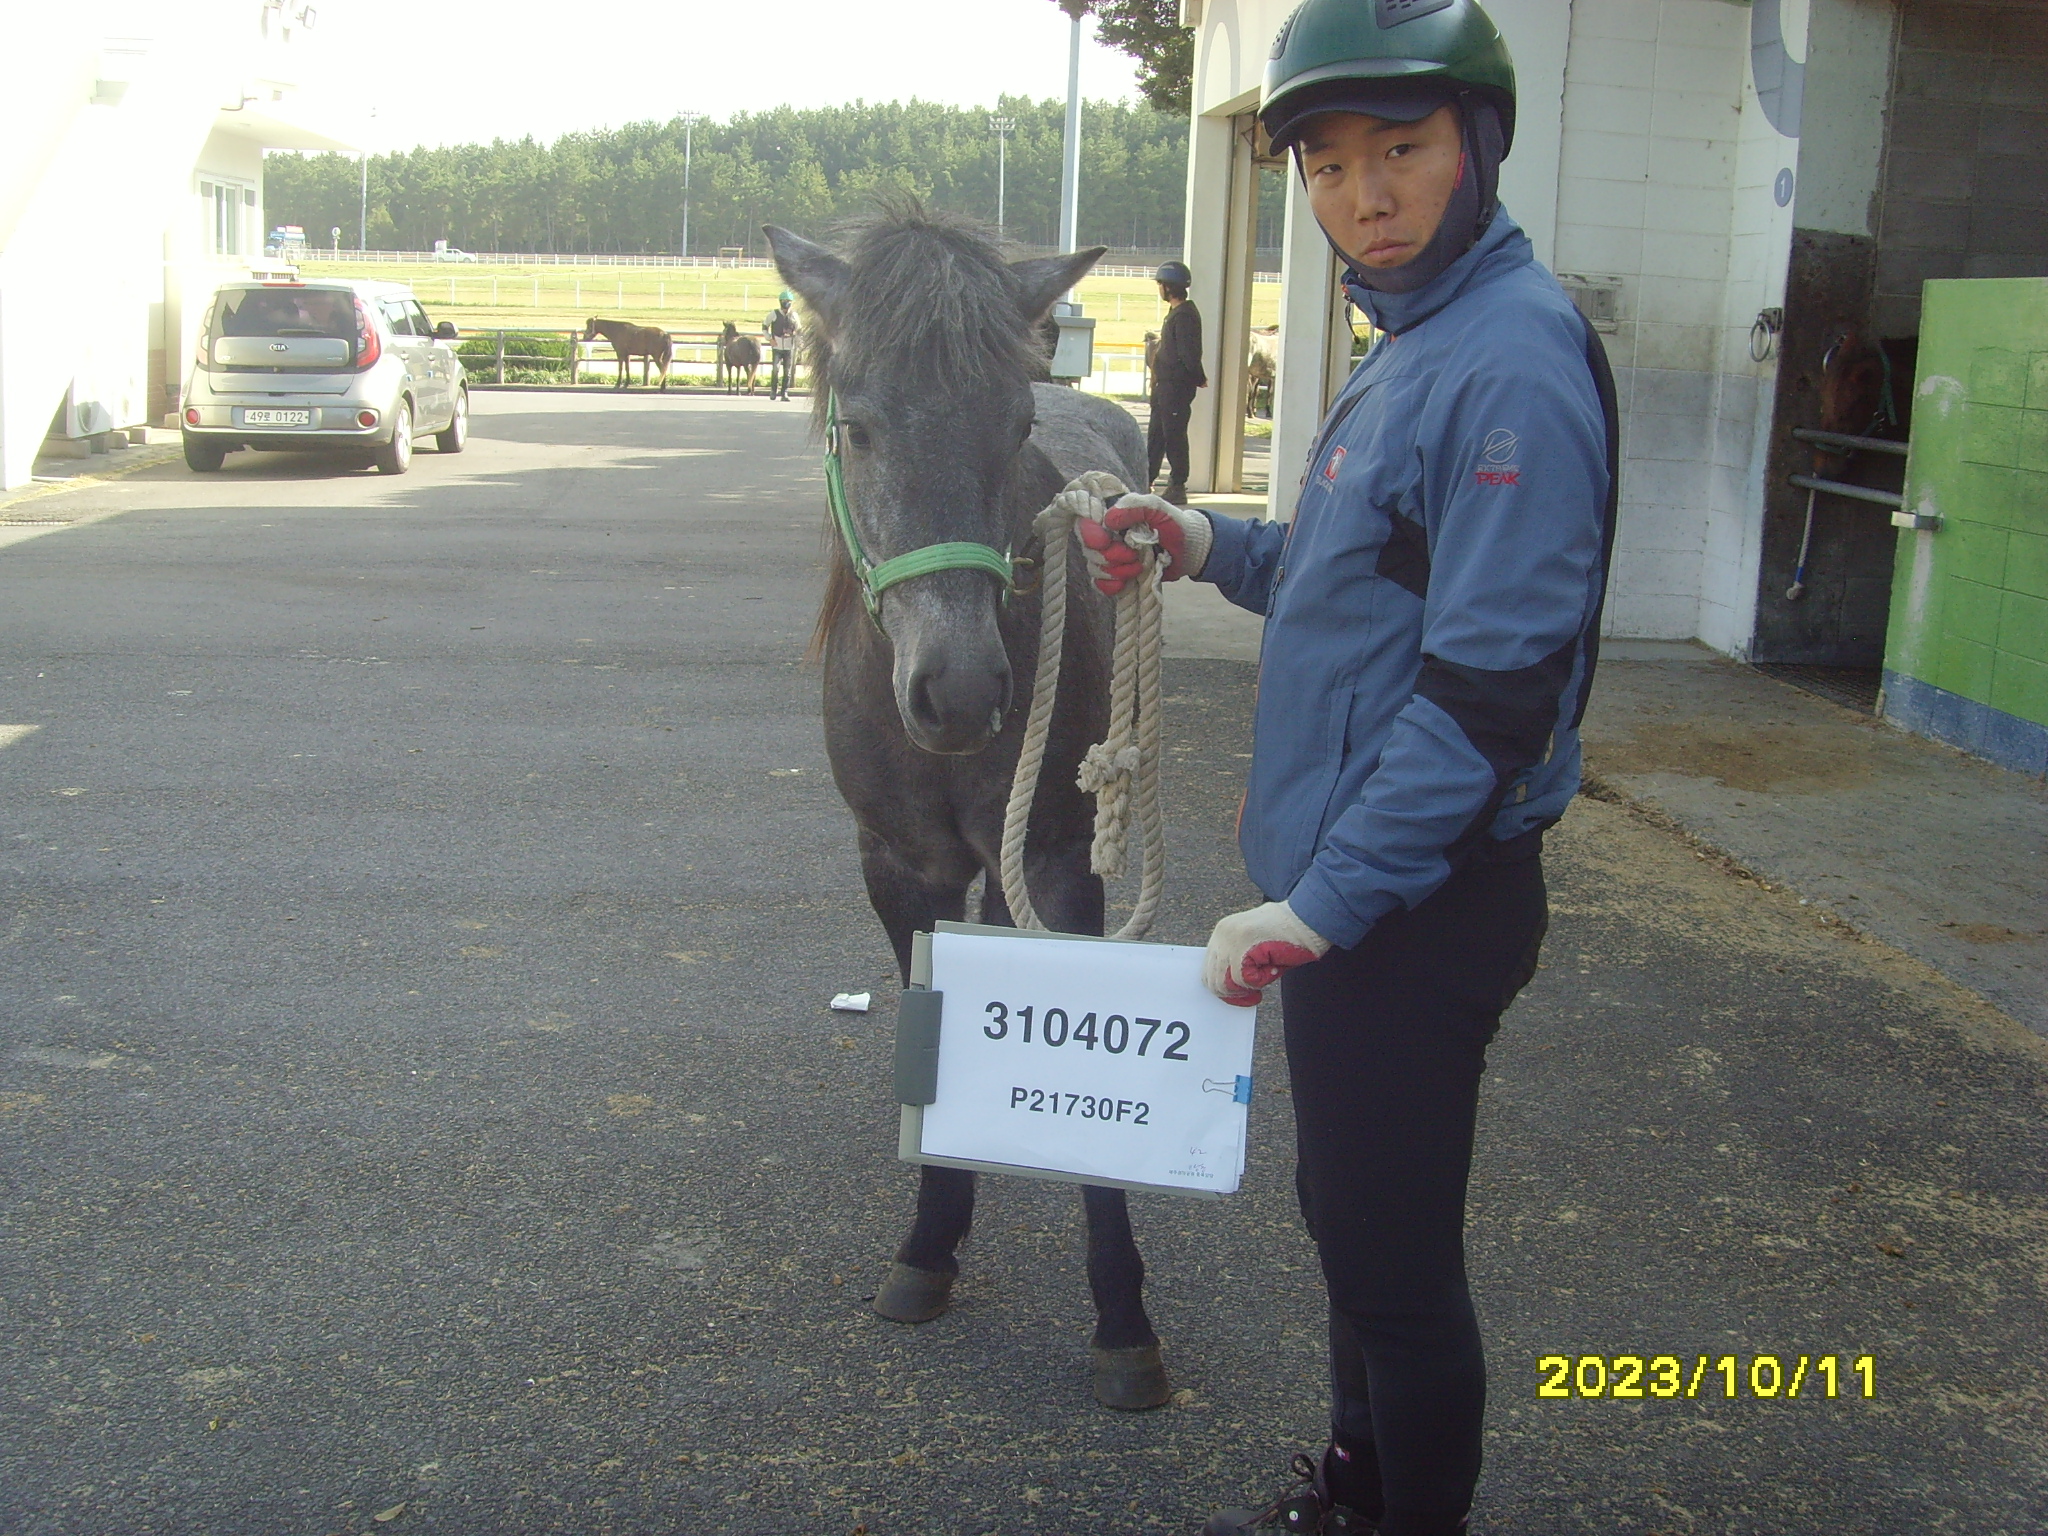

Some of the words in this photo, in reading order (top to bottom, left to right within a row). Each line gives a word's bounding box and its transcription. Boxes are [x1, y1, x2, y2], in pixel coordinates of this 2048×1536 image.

[275, 411, 303, 422] 0122
[1474, 472, 1520, 486] PEAK
[983, 1001, 1191, 1061] 3104072
[1010, 1086, 1150, 1125] P21730F2
